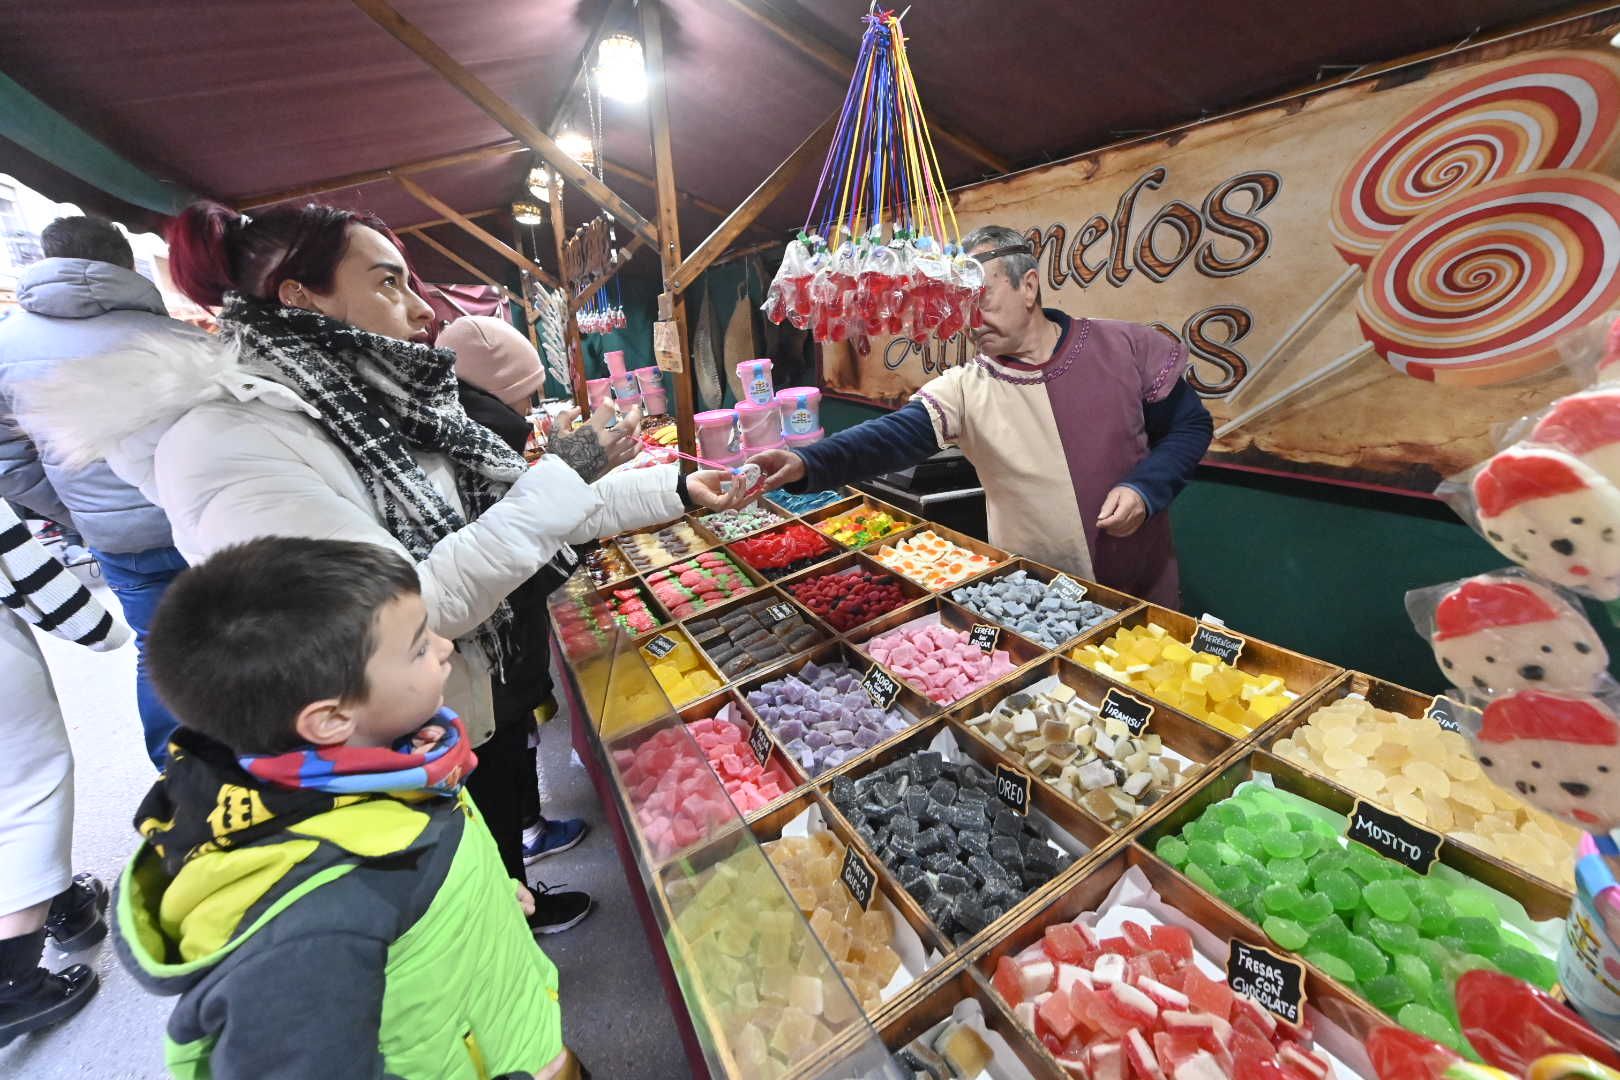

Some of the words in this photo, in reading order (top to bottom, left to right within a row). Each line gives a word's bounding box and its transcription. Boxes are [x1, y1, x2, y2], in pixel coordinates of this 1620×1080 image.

[872, 670, 894, 694] MORA
[998, 776, 1024, 805] OREO
[1355, 814, 1422, 861] MOJITO
[848, 847, 869, 889] TARTA
[1237, 946, 1285, 987] FRESAS
[1255, 976, 1283, 998] CON
[1232, 976, 1297, 1020] CHOCOLATE
